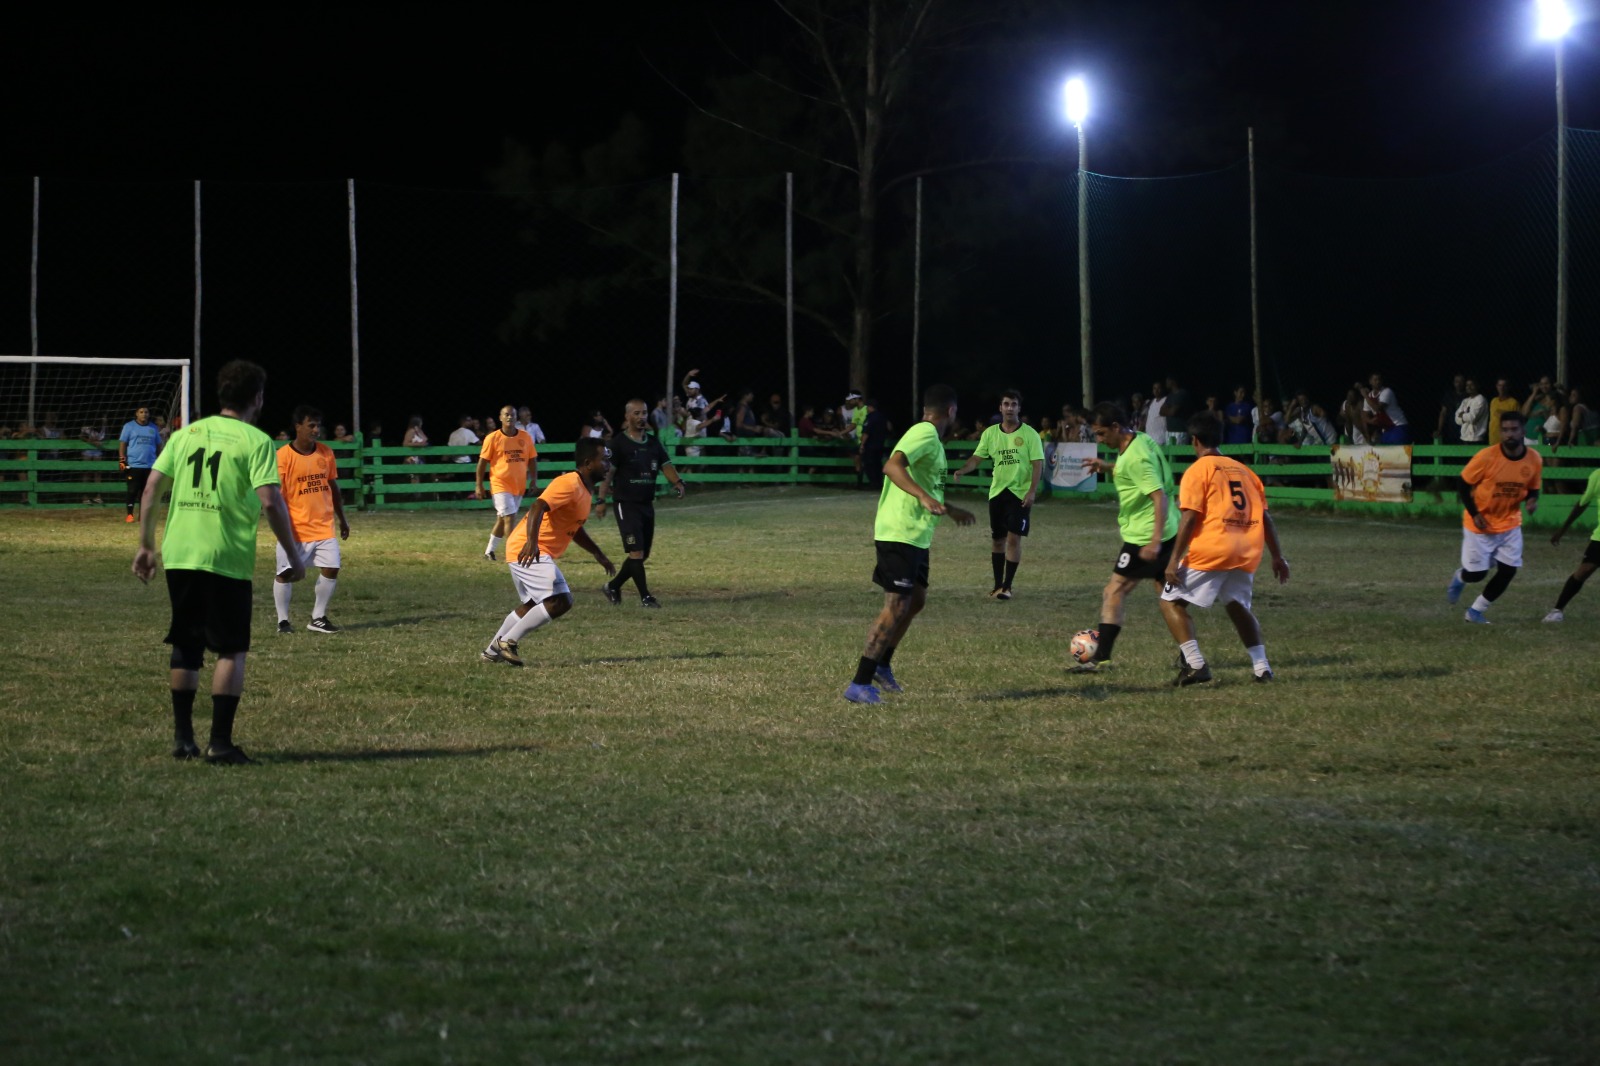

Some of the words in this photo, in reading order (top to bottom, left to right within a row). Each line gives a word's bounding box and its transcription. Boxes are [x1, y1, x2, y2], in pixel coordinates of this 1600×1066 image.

[187, 447, 222, 491] 11
[1228, 480, 1247, 511] 5
[1117, 552, 1131, 568] 9
